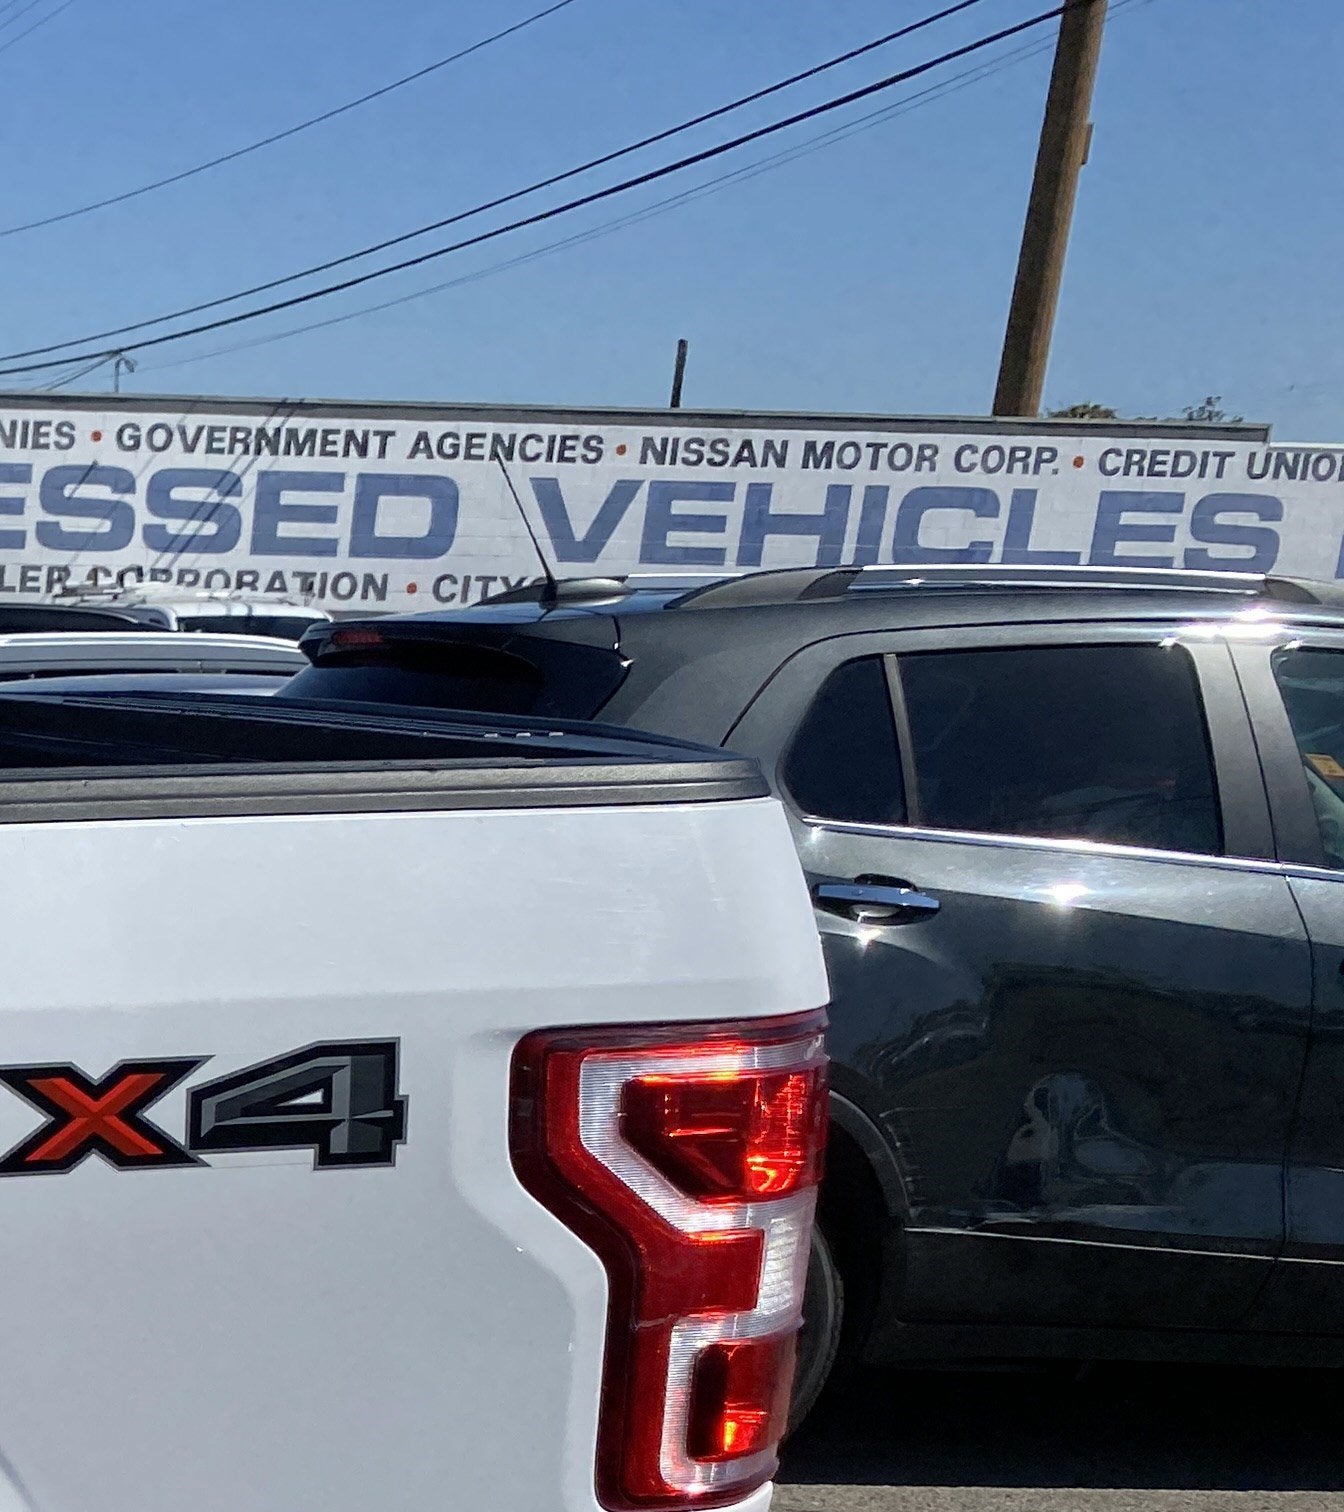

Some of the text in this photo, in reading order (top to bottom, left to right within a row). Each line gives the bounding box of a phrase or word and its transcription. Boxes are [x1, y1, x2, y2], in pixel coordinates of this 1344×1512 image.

[115, 422, 604, 464] GOVERNMENT AGENCIES
[639, 436, 1059, 477] NISSAN MOTOR CORP.
[1098, 447, 1236, 479] CREDIT
[529, 476, 1284, 573] VEHICLES
